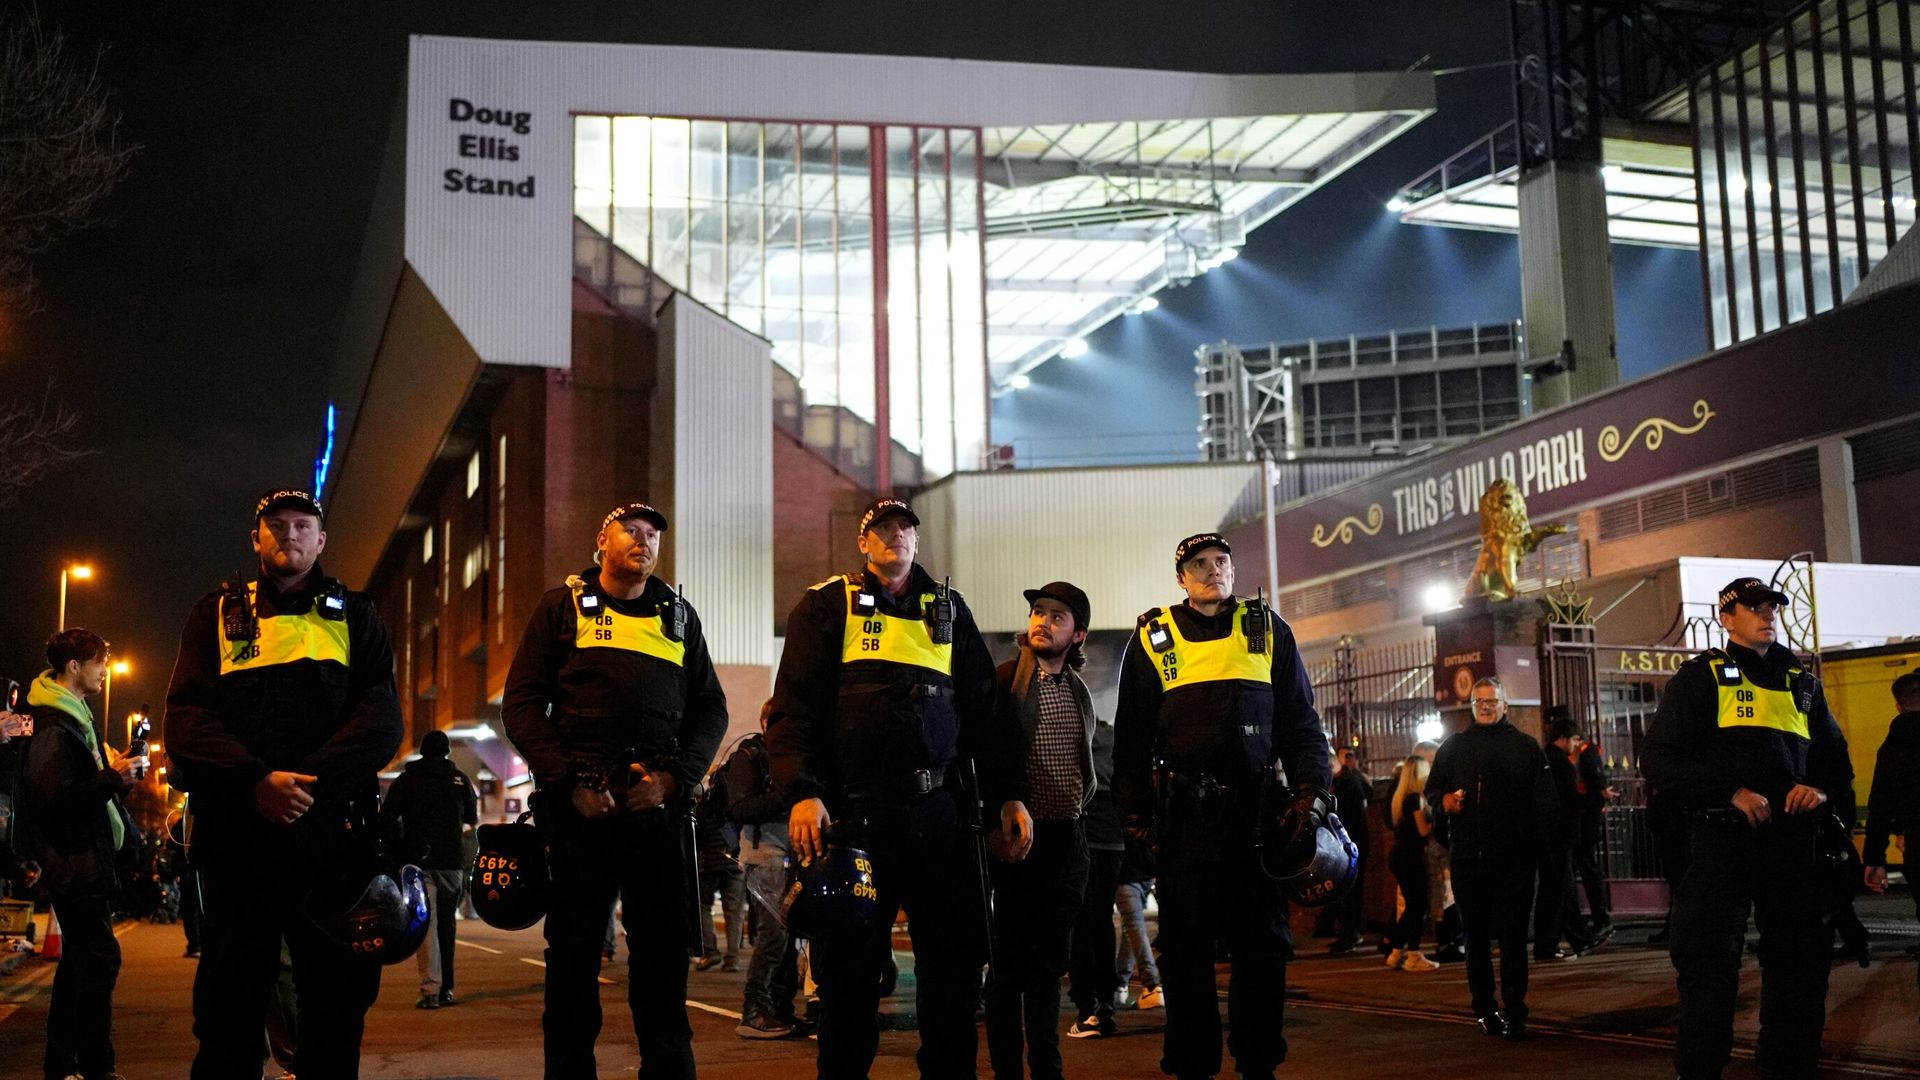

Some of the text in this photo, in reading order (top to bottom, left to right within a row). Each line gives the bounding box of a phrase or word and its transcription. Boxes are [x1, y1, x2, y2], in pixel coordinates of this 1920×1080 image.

[449, 98, 531, 135] Doug
[459, 134, 519, 162] Ellis
[444, 168, 535, 198] Stand
[1392, 477, 1439, 535] THIS
[1440, 478, 1454, 514] IS
[1519, 427, 1587, 498] PARK
[273, 490, 309, 500] POLICE
[878, 499, 907, 509] POLICE
[1187, 535, 1217, 548] POLICE
[595, 615, 613, 626] QB
[863, 620, 883, 634] QB
[595, 629, 613, 640] 5B
[862, 638, 880, 651] 5B
[1162, 652, 1177, 667] QB
[1163, 667, 1178, 682] 5B
[1736, 690, 1754, 703] QB
[1736, 706, 1754, 718] 5B
[479, 856, 518, 870] 2493
[855, 858, 872, 874] QB
